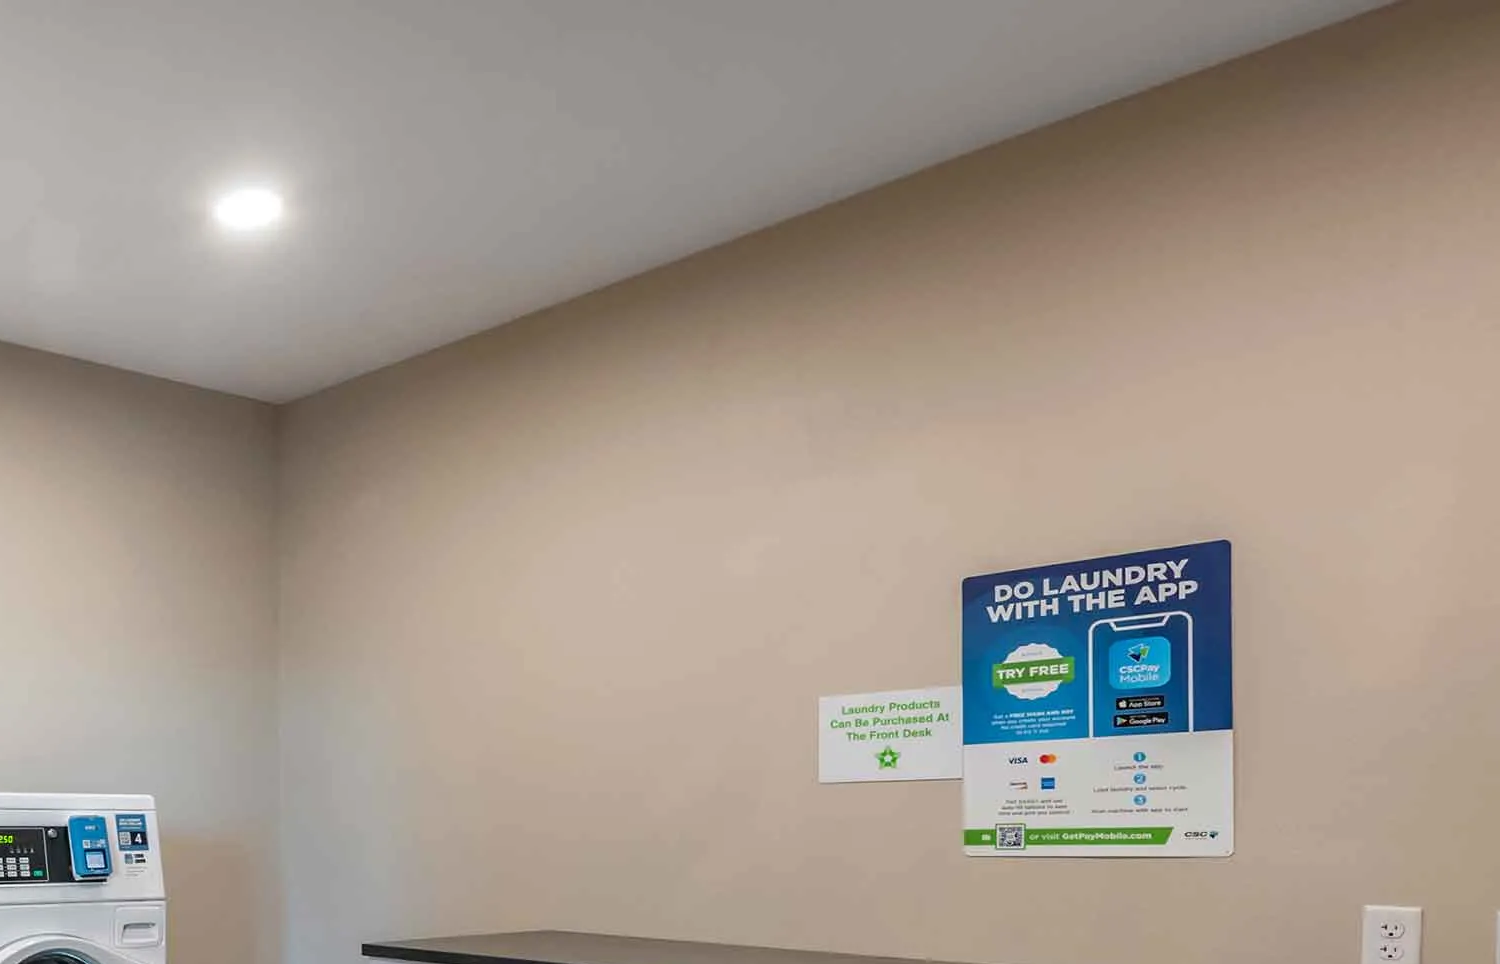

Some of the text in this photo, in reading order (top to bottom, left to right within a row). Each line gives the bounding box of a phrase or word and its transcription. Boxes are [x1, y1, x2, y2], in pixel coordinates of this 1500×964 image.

[994, 558, 1189, 603] DO LAUNDRY
[986, 580, 1199, 623] WITH THE APP
[996, 663, 1069, 680] TRY FREE
[1119, 673, 1160, 683] Mobile
[841, 700, 941, 715] Laundry Products
[830, 712, 949, 729] Can Be Purchased At
[846, 727, 932, 741] The Front Desk
[134, 833, 143, 844] 4
[1041, 832, 1060, 841] visit
